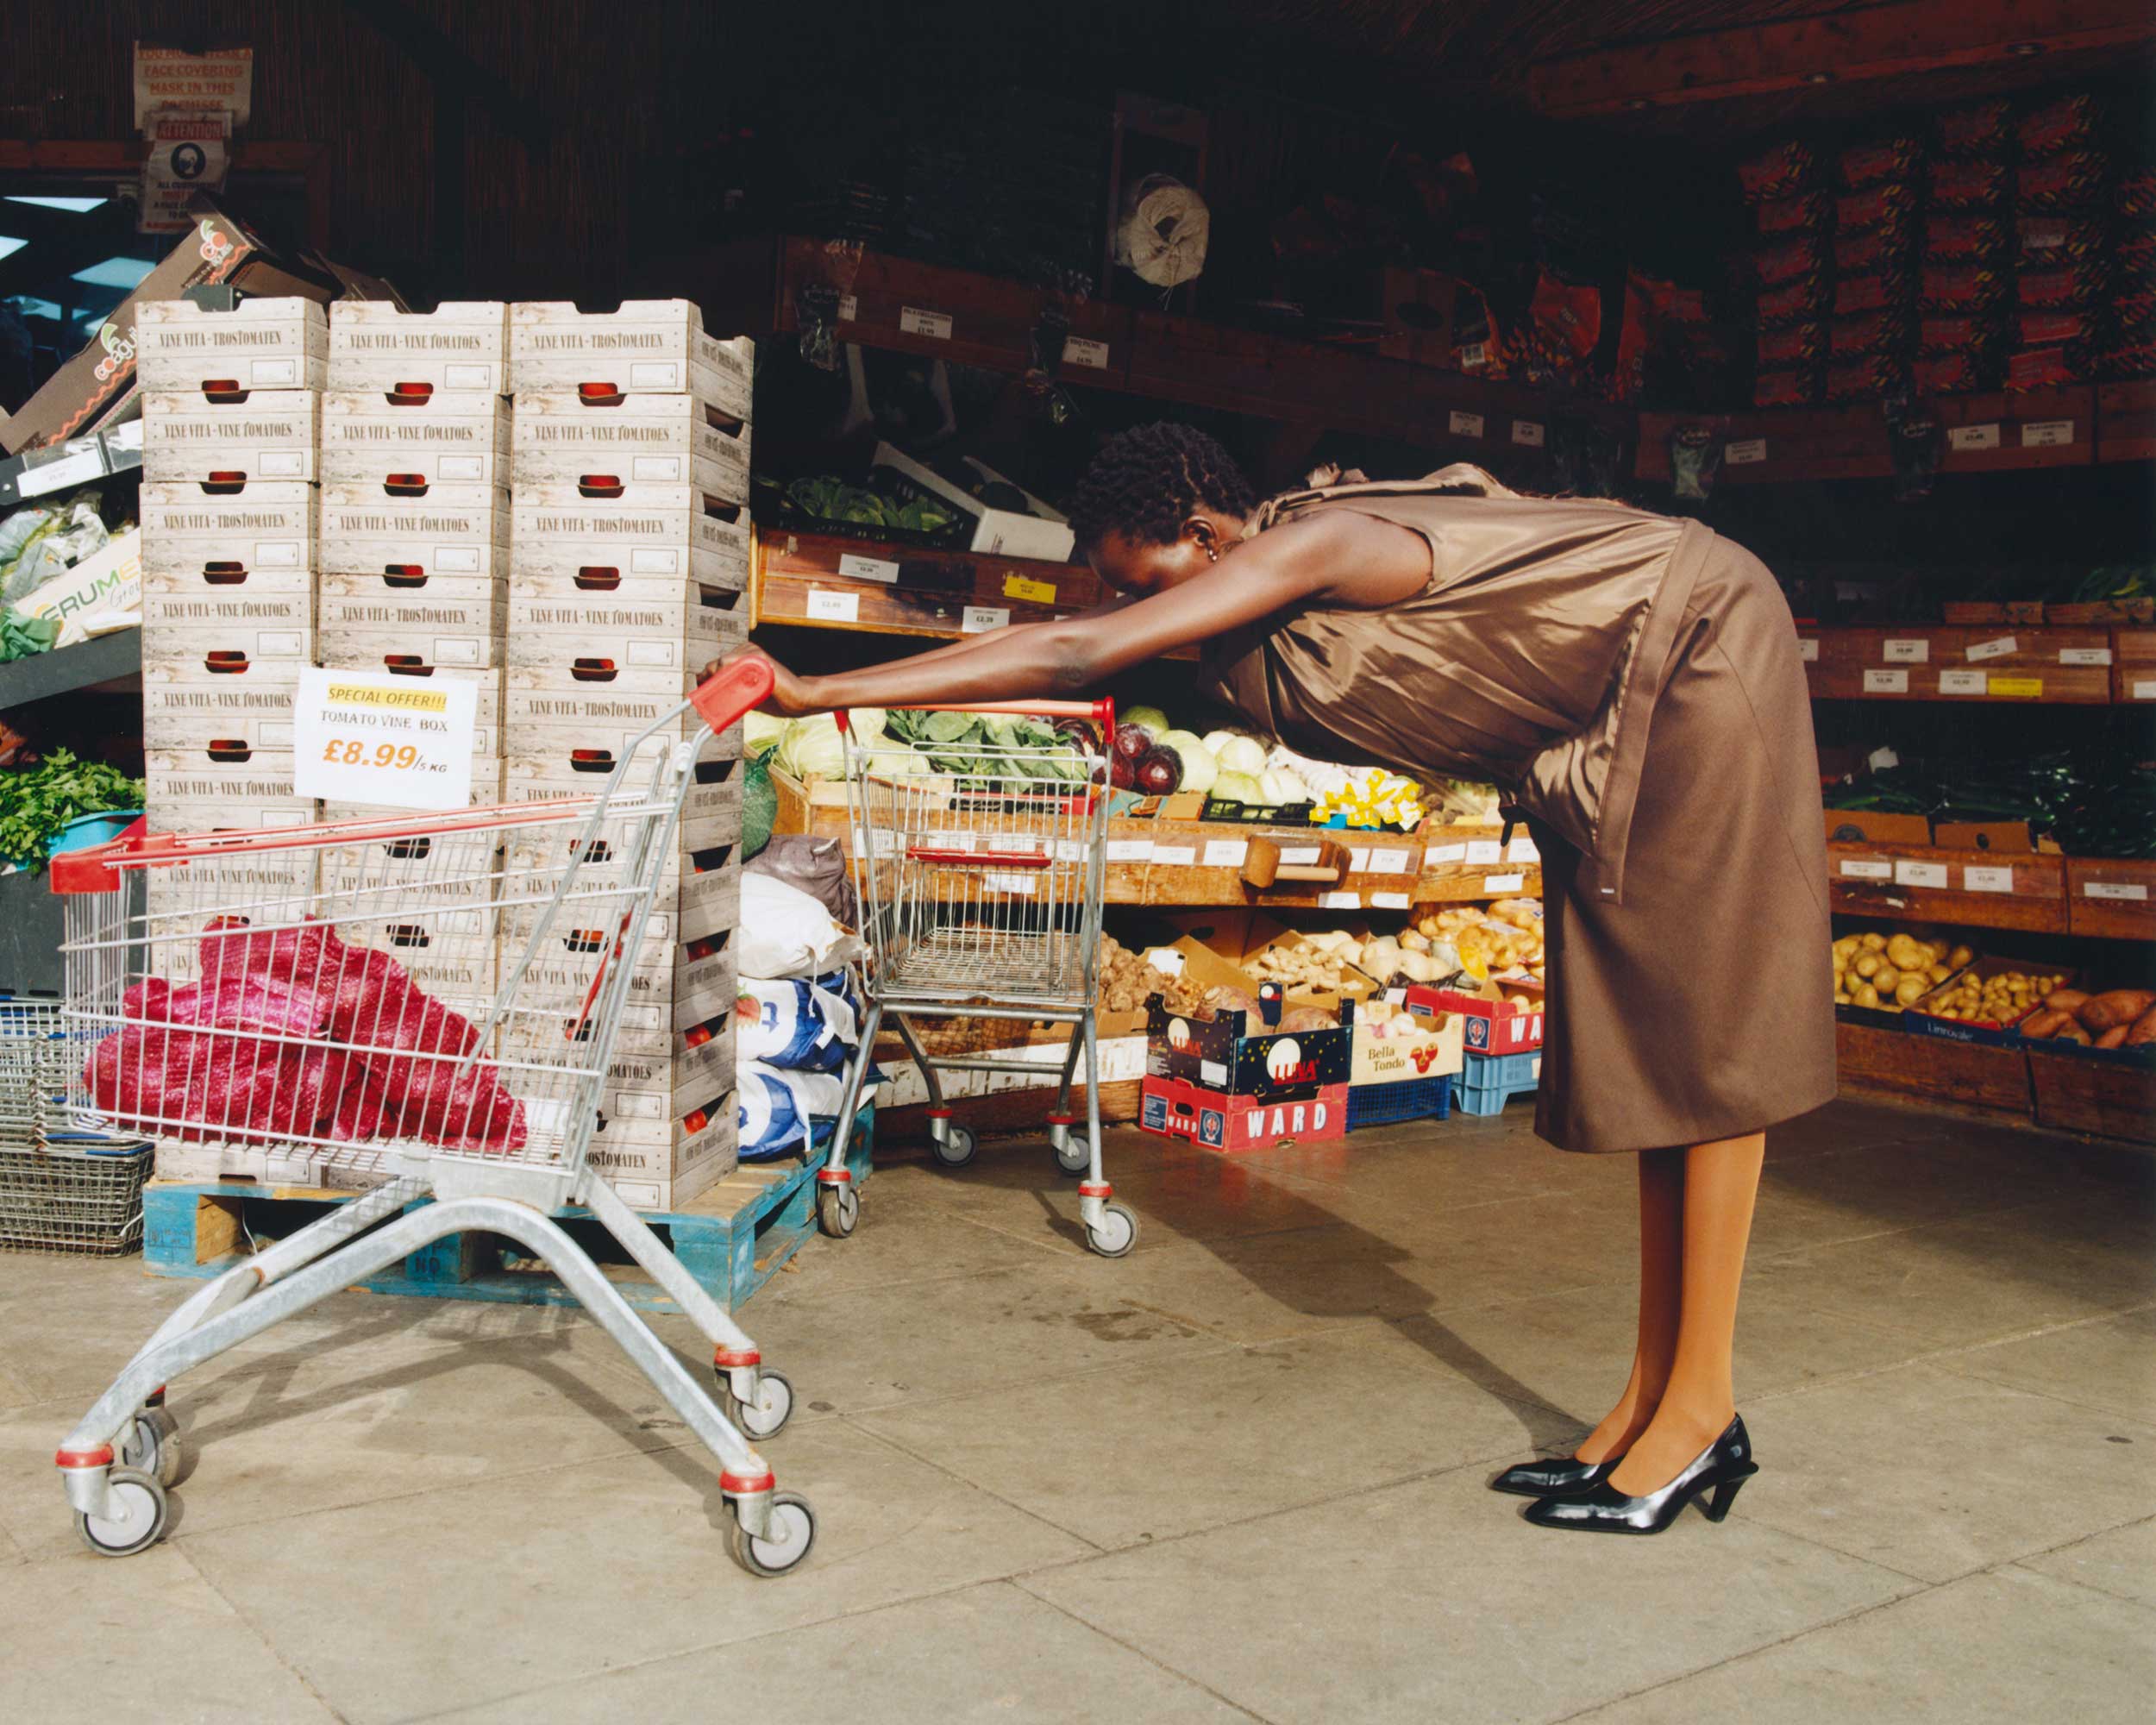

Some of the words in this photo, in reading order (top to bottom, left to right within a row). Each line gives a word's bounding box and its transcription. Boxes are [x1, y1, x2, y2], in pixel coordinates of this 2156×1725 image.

[144, 65, 173, 76] FACE
[178, 65, 243, 77] COVERING
[150, 82, 180, 93] MASK
[207, 82, 235, 93] THIS
[158, 122, 222, 138] ATTENTION
[160, 335, 181, 347] VINE
[185, 333, 205, 346] VITA
[213, 331, 281, 346] TROSTOMATEN
[350, 336, 373, 348] VINE
[375, 336, 397, 348] VITA
[405, 336, 426, 348] VINE
[429, 336, 481, 349] TOMATOES
[535, 336, 557, 348] VINE
[561, 336, 583, 348] VITA
[592, 334, 663, 348] TROSTOMATEN
[165, 425, 186, 438] VINE
[189, 424, 211, 437] VITA
[217, 424, 240, 436] VINE
[243, 423, 292, 436] TOMATOES
[343, 426, 366, 439] VINE
[368, 426, 390, 439] VITA
[398, 427, 419, 439] VINE
[423, 425, 473, 440] TOMATOES
[535, 426, 557, 440] VINE
[561, 426, 584, 440] VITA
[592, 427, 614, 440] VINE
[617, 425, 669, 441] TOMATOES
[164, 516, 185, 529] VINE
[188, 516, 210, 528] VITA
[217, 513, 285, 528] TROSTOMATEN
[340, 517, 361, 530] VINE
[365, 518, 386, 530] VITA
[394, 518, 416, 530] VINE
[419, 518, 469, 532] TOMATOES
[536, 518, 559, 531] VINE
[562, 518, 585, 531] VITA
[592, 518, 664, 533] TROSTOMATEN
[163, 604, 185, 618] VINE
[187, 604, 210, 617] VITA
[216, 604, 238, 617] VINE
[241, 602, 291, 617] TOMATOES
[342, 607, 364, 621] VINE
[367, 608, 390, 621] VITA
[397, 607, 466, 624] TROSTOMATEN
[530, 609, 552, 623] VINE
[555, 610, 578, 624] VITA
[586, 611, 608, 624] VINE
[612, 610, 662, 625] TOMATOES
[164, 693, 186, 707] VINE
[189, 693, 211, 706] VITA
[217, 694, 240, 706] VINE
[243, 693, 292, 707] TOMATOES
[329, 687, 380, 703] SPECIAL
[386, 693, 447, 709] OFFER!!!
[530, 700, 552, 714] VINE
[555, 701, 577, 715] VITA
[585, 702, 657, 718] TROSTOMATEN
[321, 710, 376, 725] TOMATO
[381, 715, 411, 729] VINE
[420, 718, 448, 732] BOX
[429, 764, 448, 773] KG
[167, 781, 189, 795] VINE
[191, 781, 214, 794] VITA
[221, 782, 242, 794] VINE
[246, 781, 295, 796] TOMATOES
[1172, 1036, 1201, 1057] LUNA
[1368, 1045, 1395, 1060] Bella
[607, 1063, 652, 1080] OMATOES
[1373, 1057, 1406, 1072] Tondo
[1273, 1060, 1318, 1086] LUNA
[1167, 1115, 1197, 1132] WARD
[1247, 1102, 1326, 1138] WARD
[586, 1151, 647, 1168] OSTOMATEN
